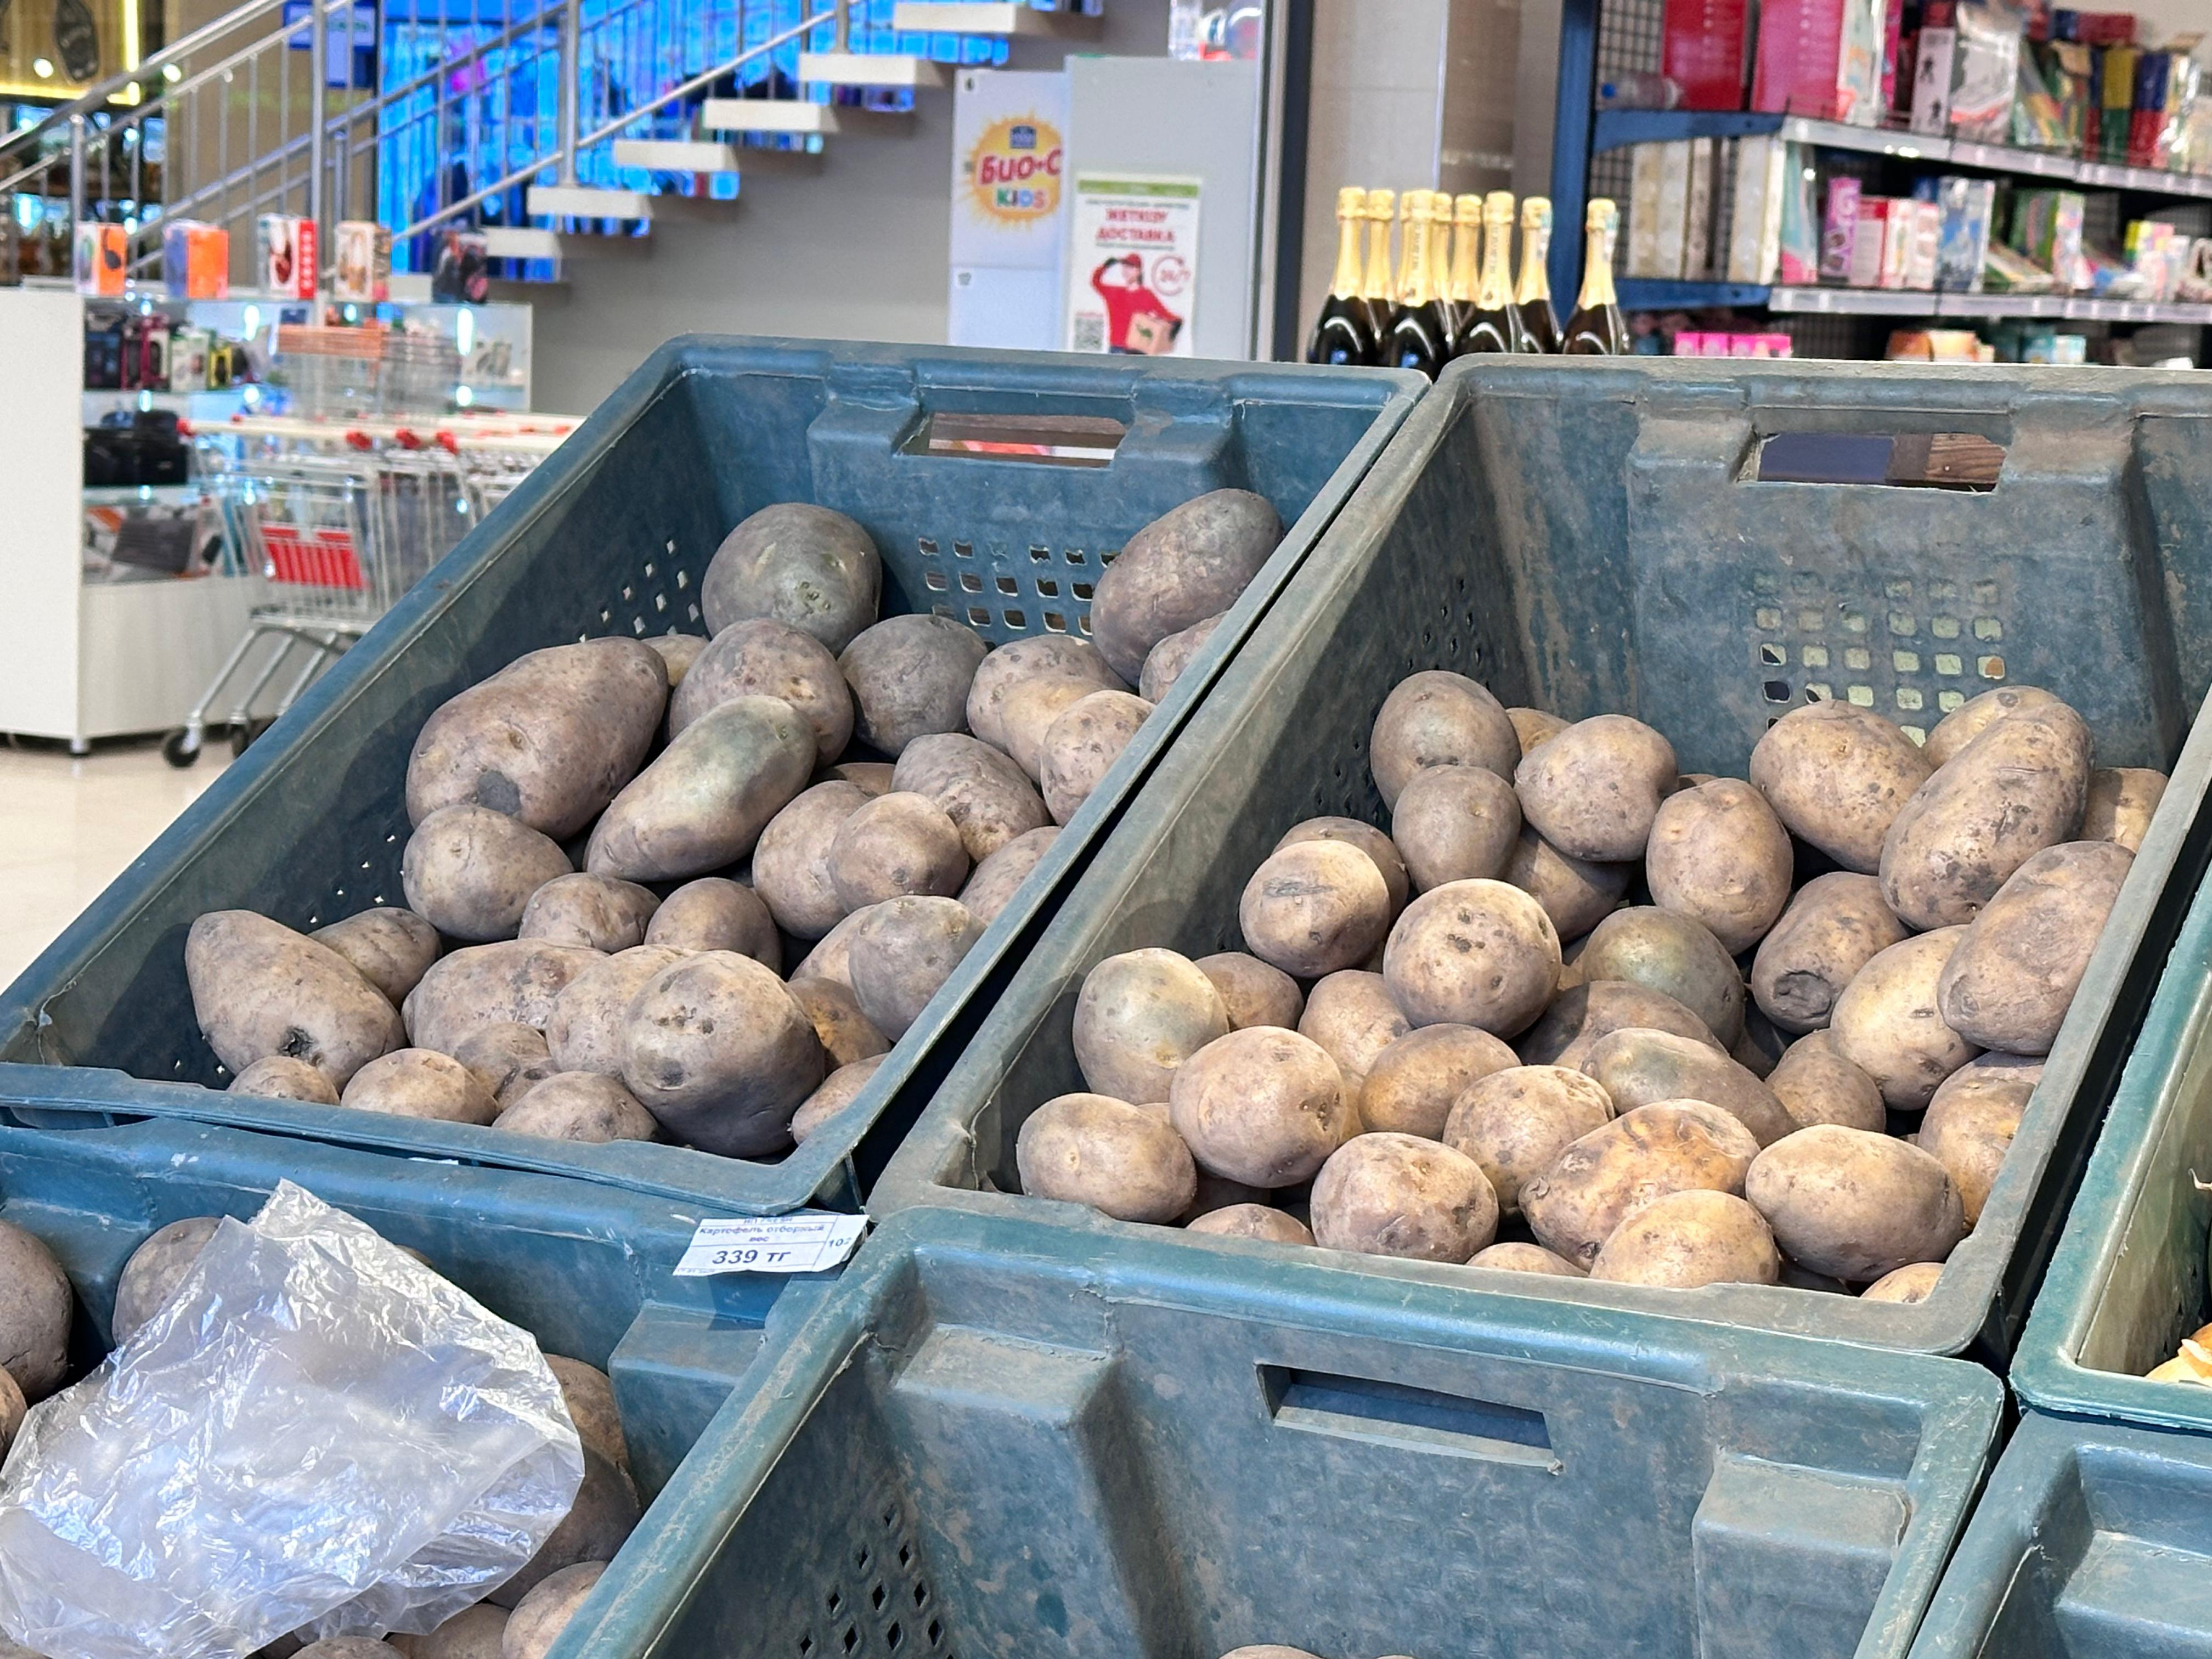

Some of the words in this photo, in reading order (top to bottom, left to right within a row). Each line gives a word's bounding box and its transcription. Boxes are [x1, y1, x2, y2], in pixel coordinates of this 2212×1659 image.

[997, 188, 1046, 209] KIDS
[699, 1227, 763, 1235] Картофель
[712, 1250, 758, 1264] 339
[767, 1251, 791, 1262] тг
